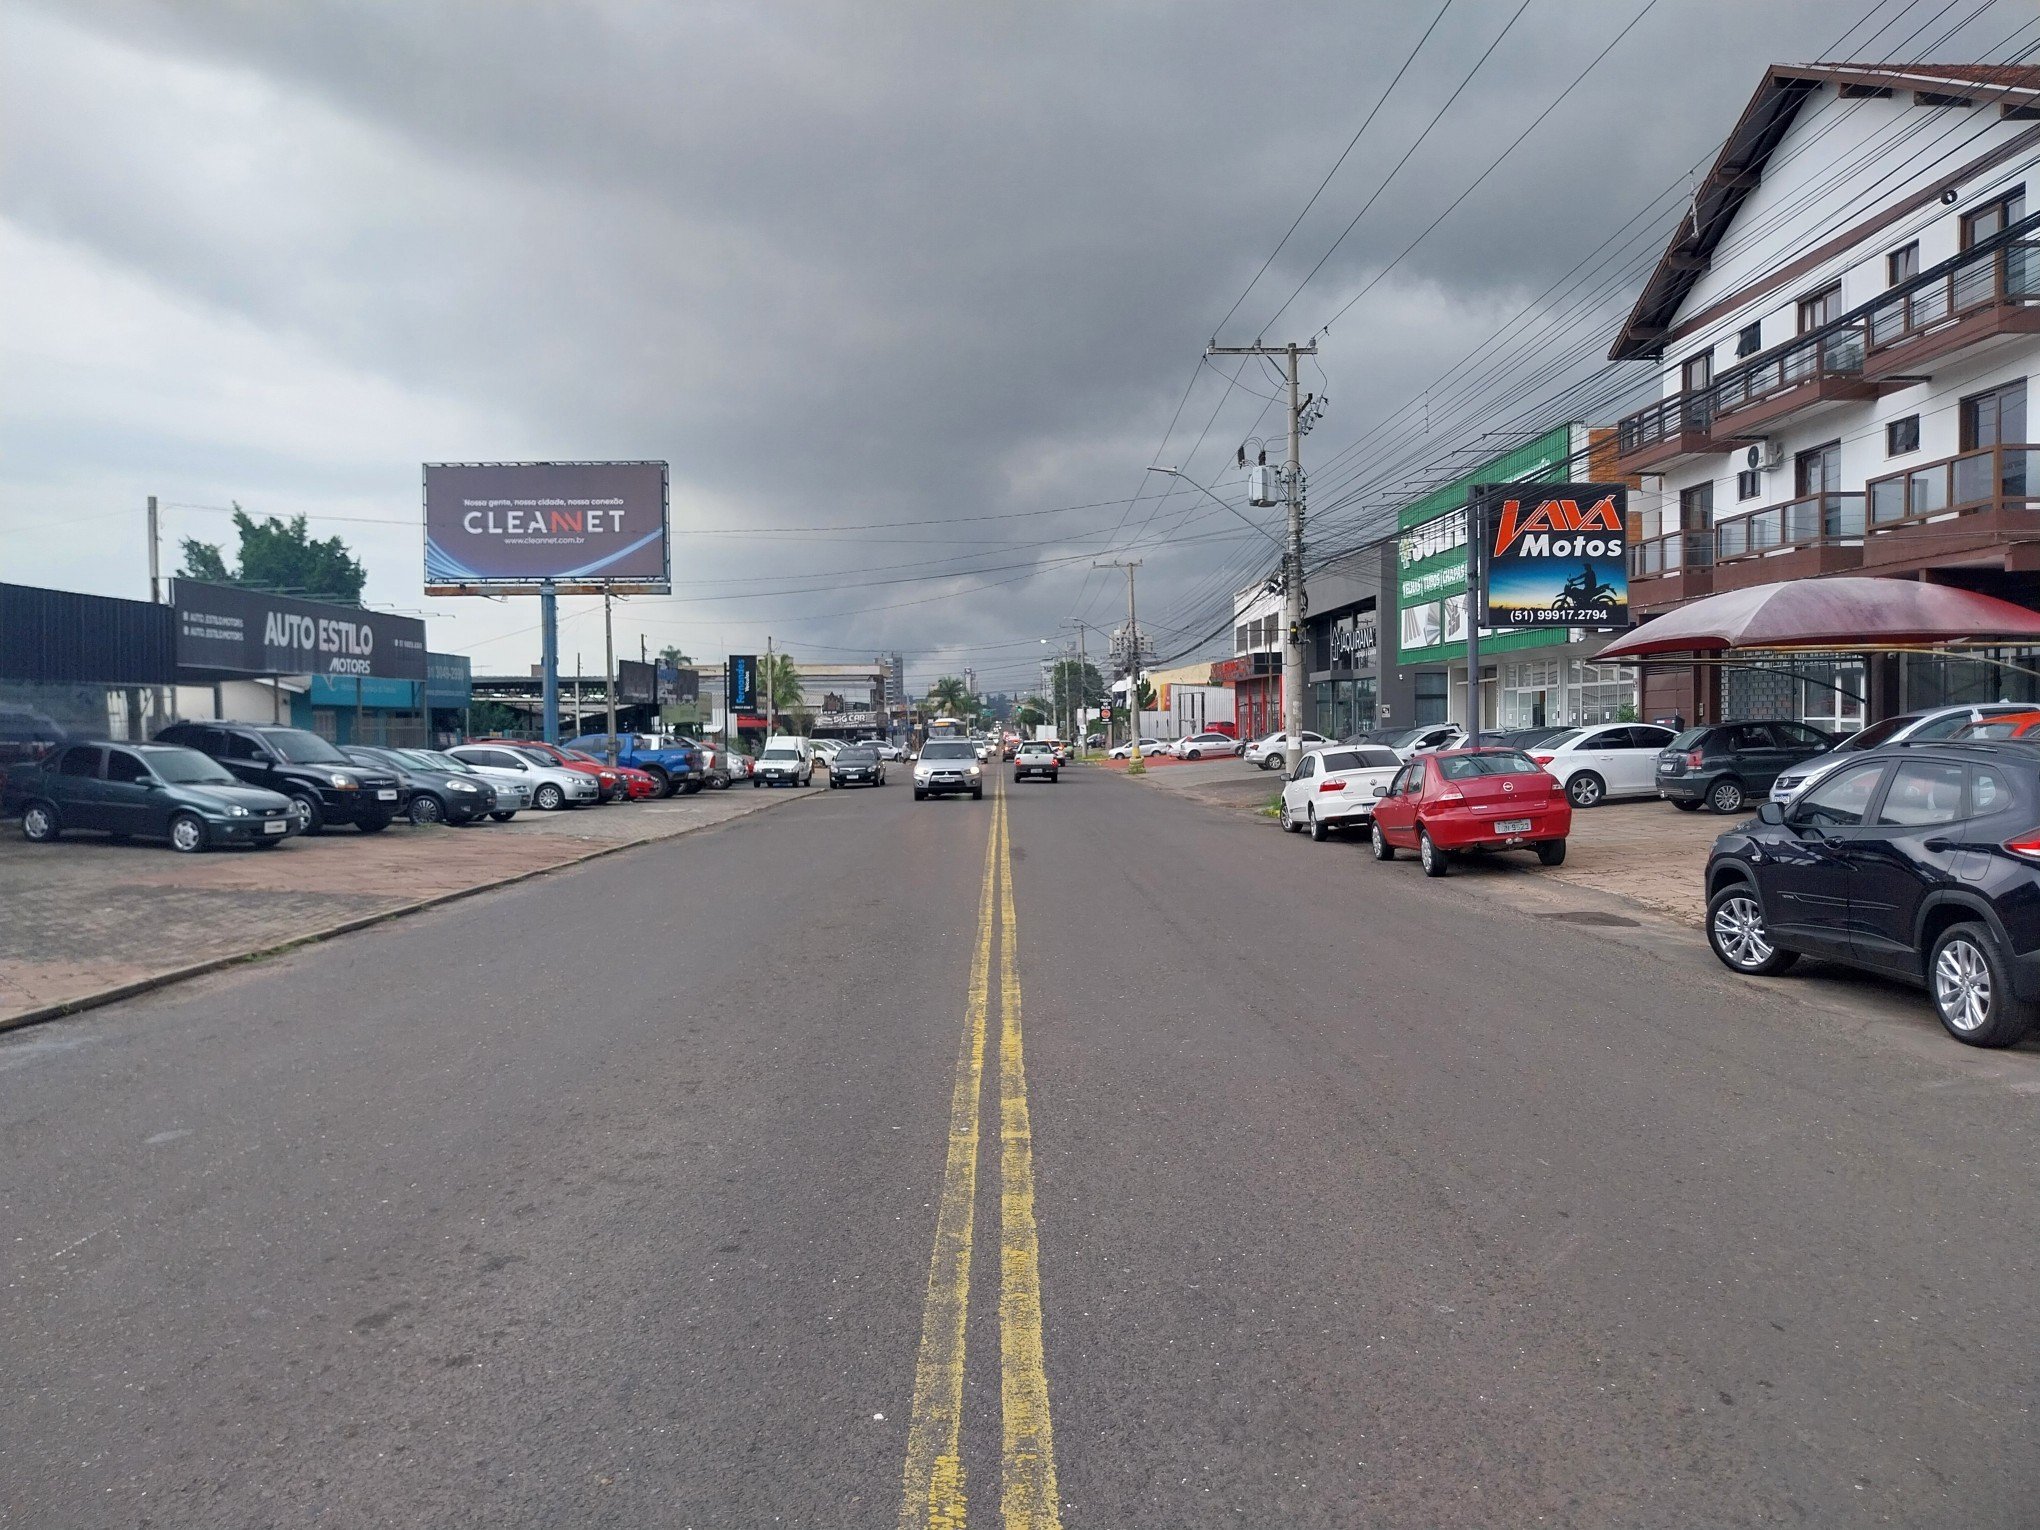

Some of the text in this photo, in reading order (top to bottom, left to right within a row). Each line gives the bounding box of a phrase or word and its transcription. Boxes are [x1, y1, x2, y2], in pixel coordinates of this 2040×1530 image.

[488, 499, 512, 507] gente,
[537, 498, 566, 506] cidade,
[591, 497, 624, 506] conexão
[463, 510, 625, 534] CLEANNET
[504, 536, 585, 545] www.cleannet.com.br
[1519, 533, 1622, 557] Motos
[1510, 609, 1608, 622] (51) 99917.2794
[264, 612, 374, 656] AUTO ESTILO
[329, 656, 371, 674] MOTORS
[736, 658, 745, 704] Fernandes
[848, 713, 866, 722] CAR
